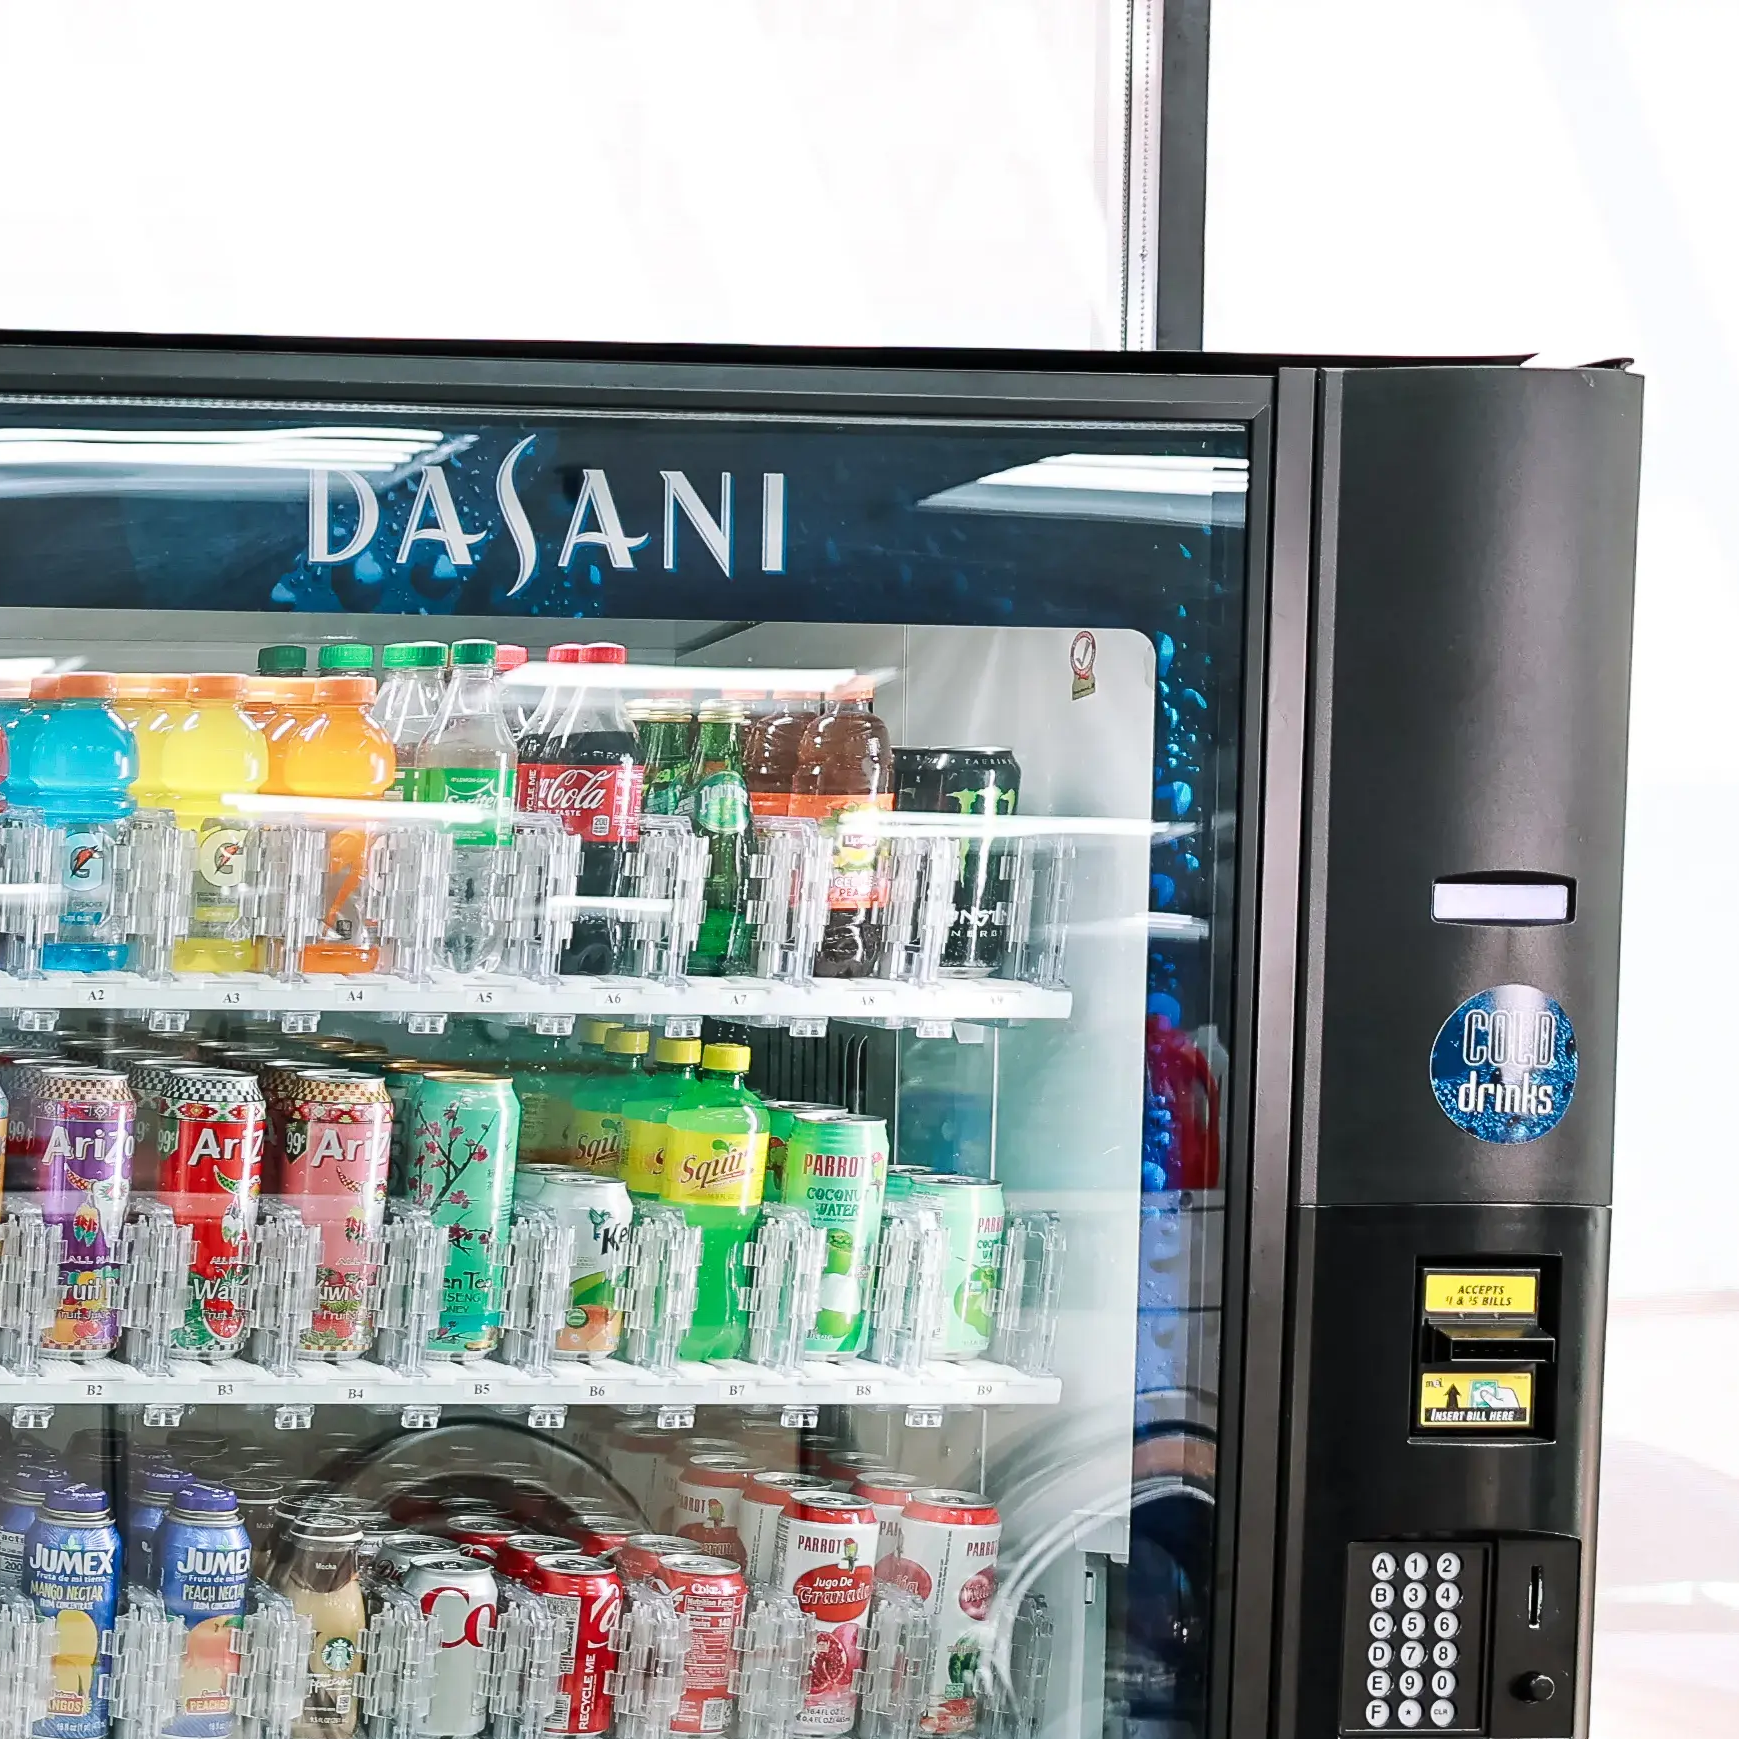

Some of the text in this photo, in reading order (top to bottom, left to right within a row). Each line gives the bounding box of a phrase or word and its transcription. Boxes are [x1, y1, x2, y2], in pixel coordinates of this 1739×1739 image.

[308, 433, 788, 597] DASANI
[87, 988, 105, 1002] A2
[346, 988, 363, 1002] A4
[1463, 1009, 1555, 1066] COLD
[1458, 1069, 1554, 1116] drinks
[803, 1154, 867, 1178] PARROT
[807, 1187, 870, 1201] COCONUT
[816, 1201, 860, 1217] WATER
[1458, 1285, 1504, 1295] ACCEPTS
[1456, 1297, 1465, 1306] &
[1482, 1297, 1513, 1306] BILLS
[87, 1384, 103, 1397] B2
[347, 1388, 364, 1401] B4
[728, 1384, 746, 1397] B7
[1431, 1408, 1515, 1422] INSERT BILL HERE
[797, 1535, 842, 1553] PARROT
[29, 1548, 114, 1576] JUMEX
[176, 1548, 253, 1576] JUMEX
[315, 1562, 338, 1571] Mocha
[813, 1577, 854, 1589] Jugo De
[29, 1580, 104, 1601] MANGO NECTAR
[798, 1584, 871, 1608] Granada
[579, 1655, 595, 1732] RECYCLE ME
[188, 1699, 230, 1713] PEACHES
